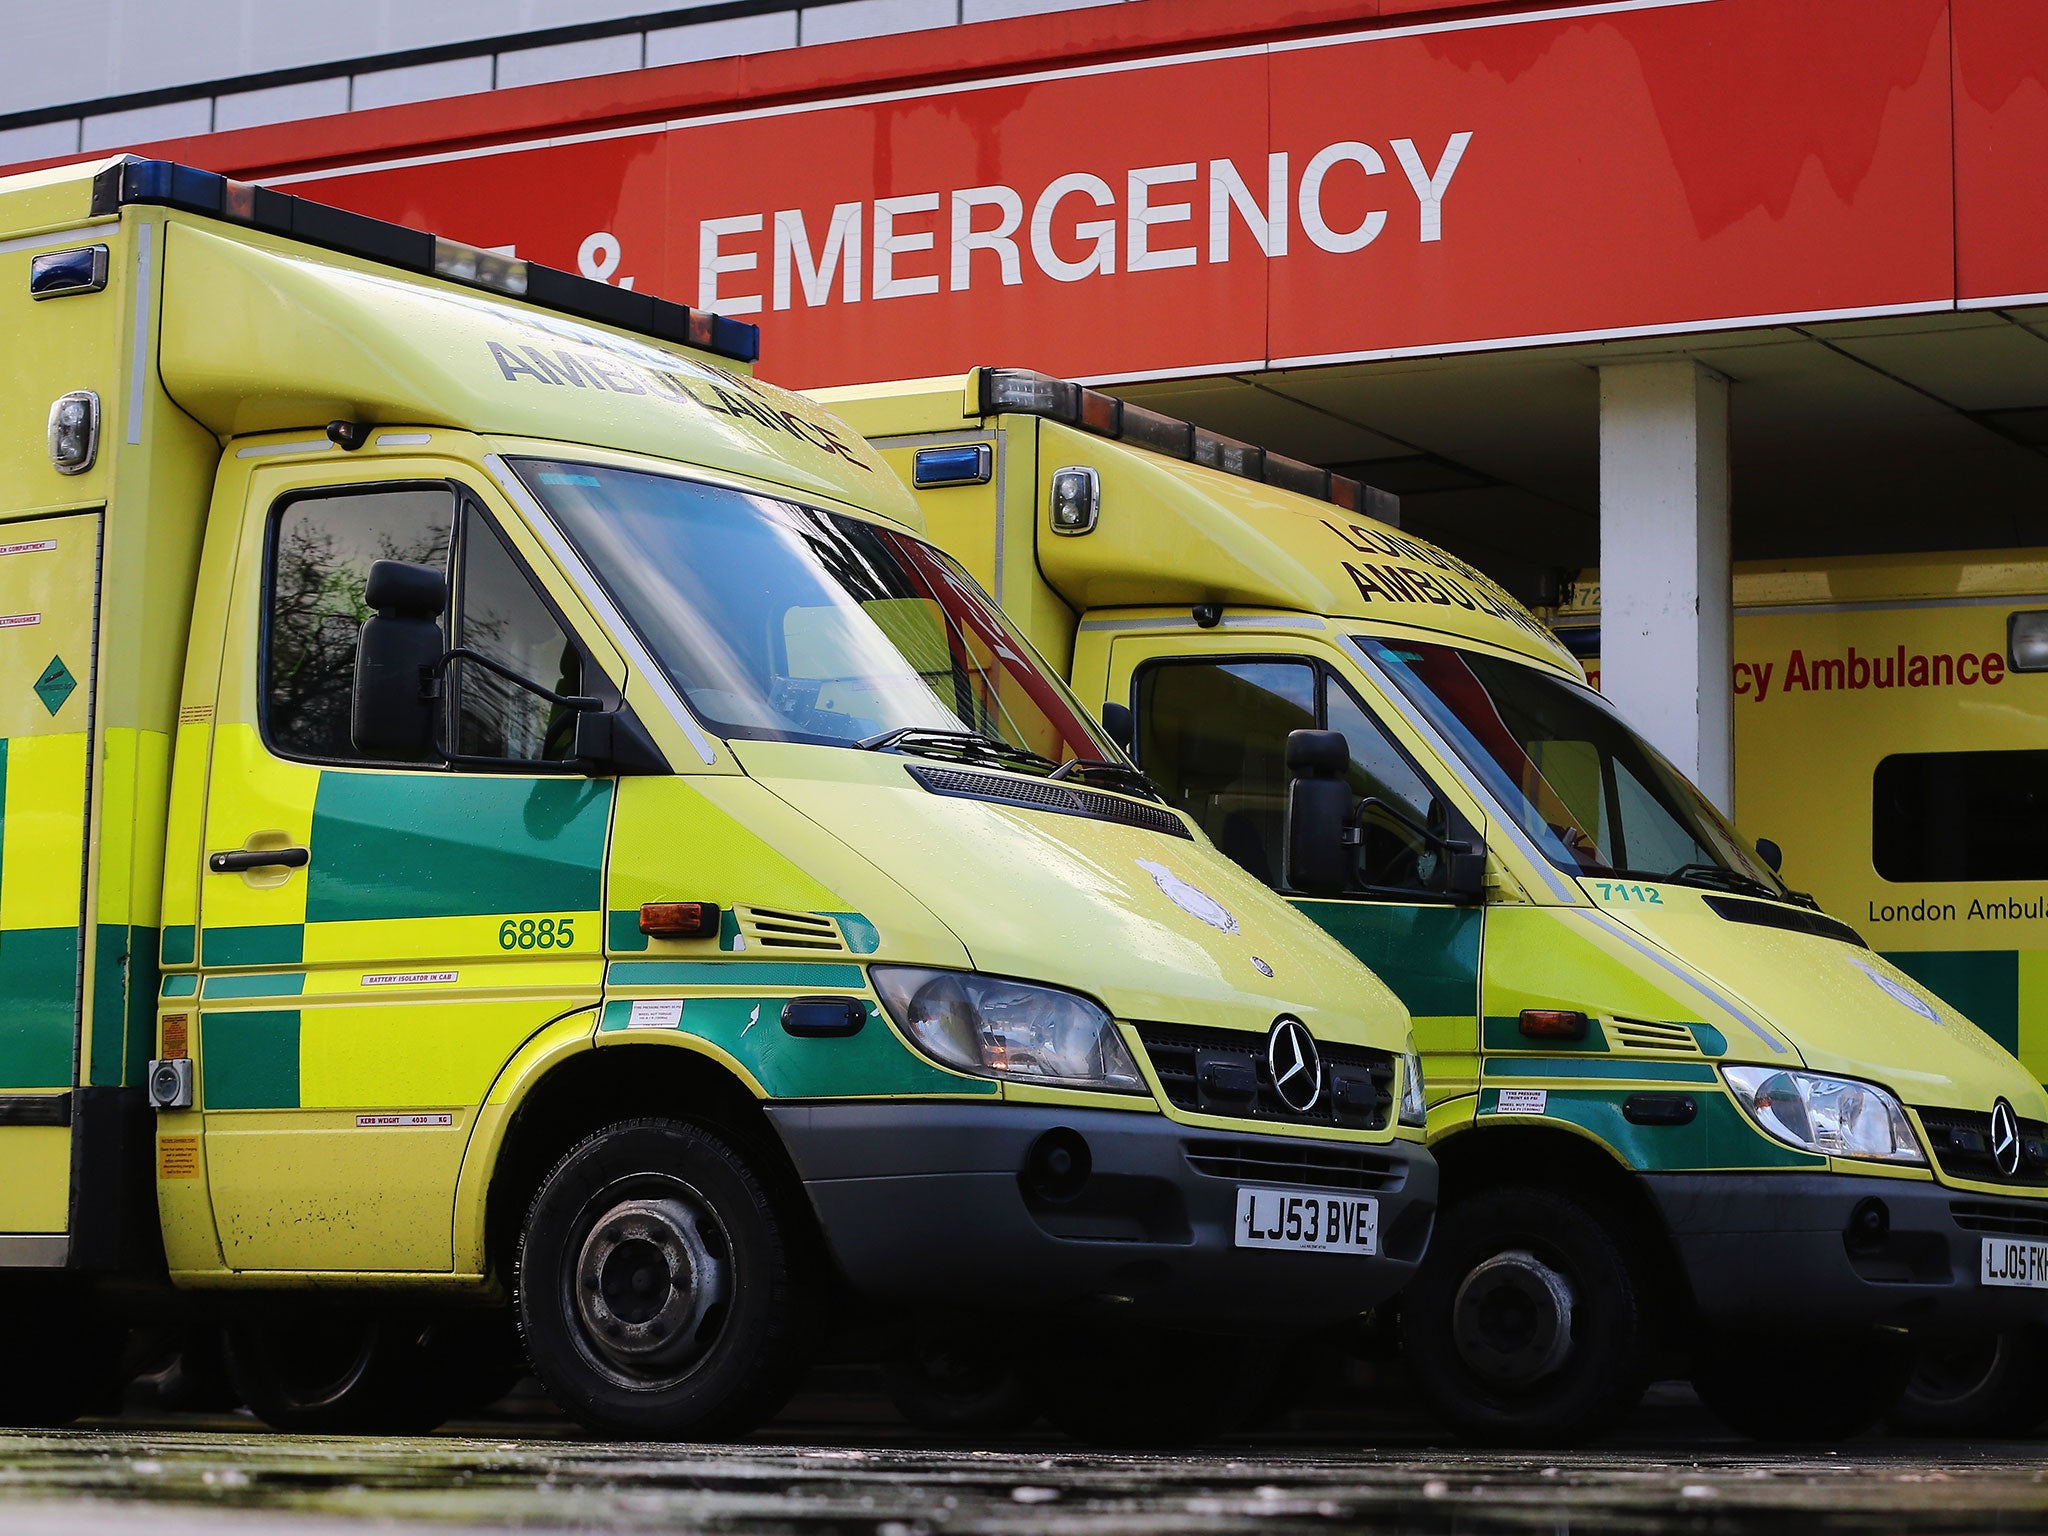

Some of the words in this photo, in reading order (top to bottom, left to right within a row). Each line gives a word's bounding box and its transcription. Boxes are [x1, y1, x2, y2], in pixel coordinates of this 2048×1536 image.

[698, 131, 1474, 317] EMERGENCY
[486, 341, 874, 474] AMBULANCE
[1782, 645, 2005, 692] Ambulance
[1595, 883, 1664, 905] 7112
[1869, 899, 1956, 923] London
[1967, 895, 2048, 921] Ambul
[499, 918, 575, 950] 6885
[398, 975, 429, 983] ISOLATOR
[377, 1117, 400, 1125] WEIGHT
[438, 1116, 448, 1124] KG
[1248, 1195, 1319, 1242] LJ53
[1326, 1200, 1369, 1245] BVE
[1988, 1243, 2027, 1280] LJ05
